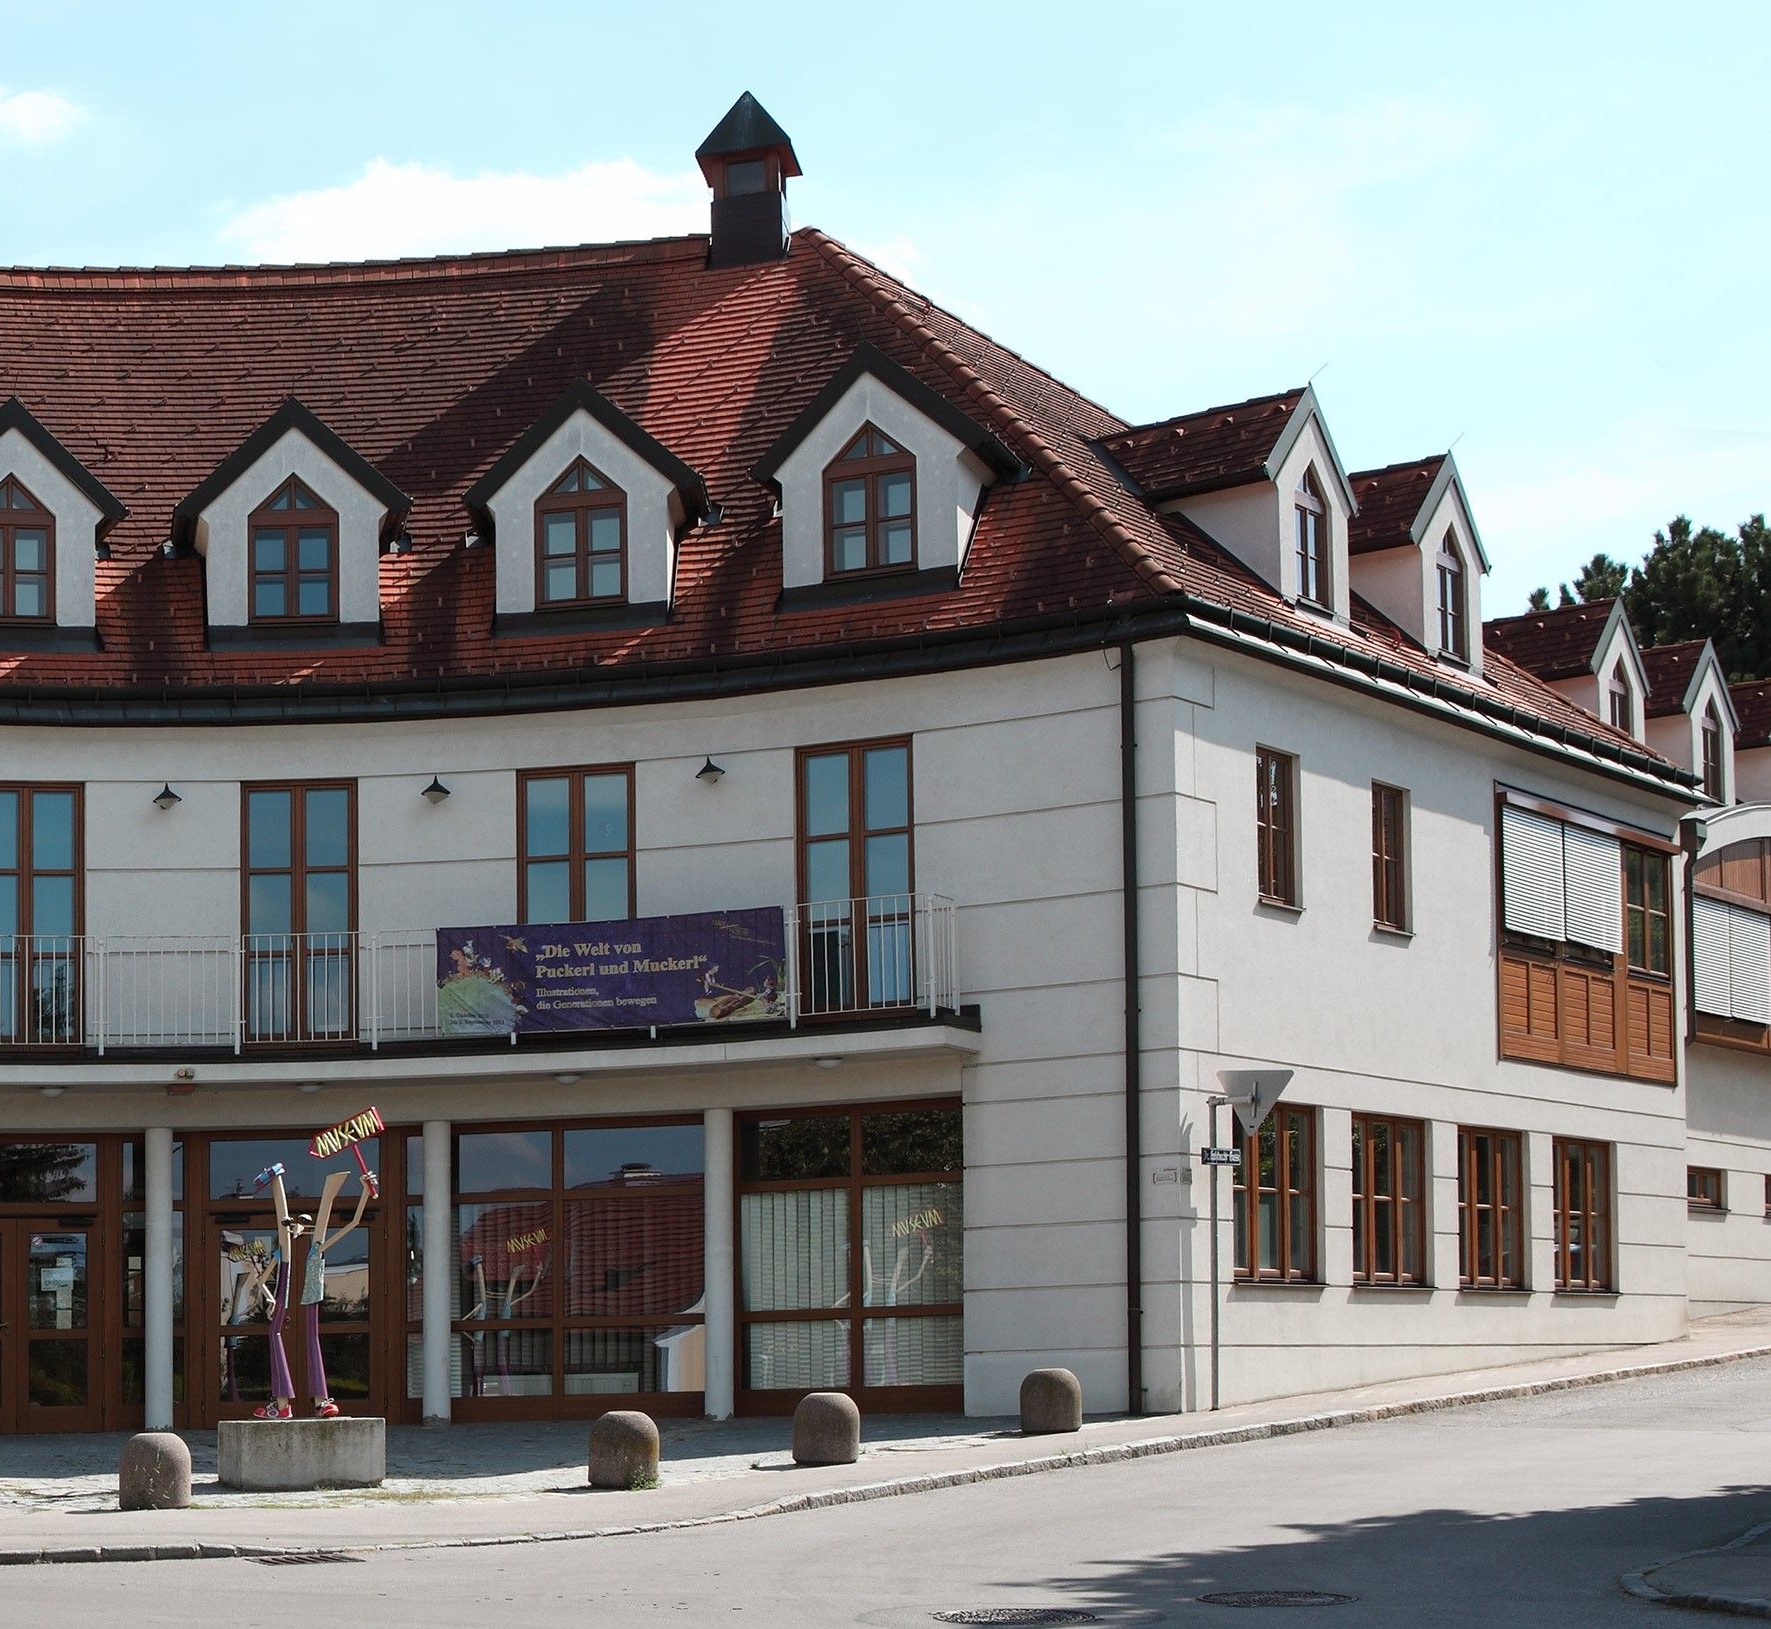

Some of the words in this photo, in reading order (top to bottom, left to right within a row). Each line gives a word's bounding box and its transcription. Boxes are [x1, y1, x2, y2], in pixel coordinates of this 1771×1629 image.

[574, 943, 610, 956] Welt
[613, 943, 642, 954] von
[535, 964, 595, 979] Puckerl
[599, 961, 628, 976] und
[536, 987, 600, 998] Illustrationen,
[536, 1001, 551, 1010] die
[553, 999, 614, 1010] Generationen
[616, 997, 657, 1007] bewegen
